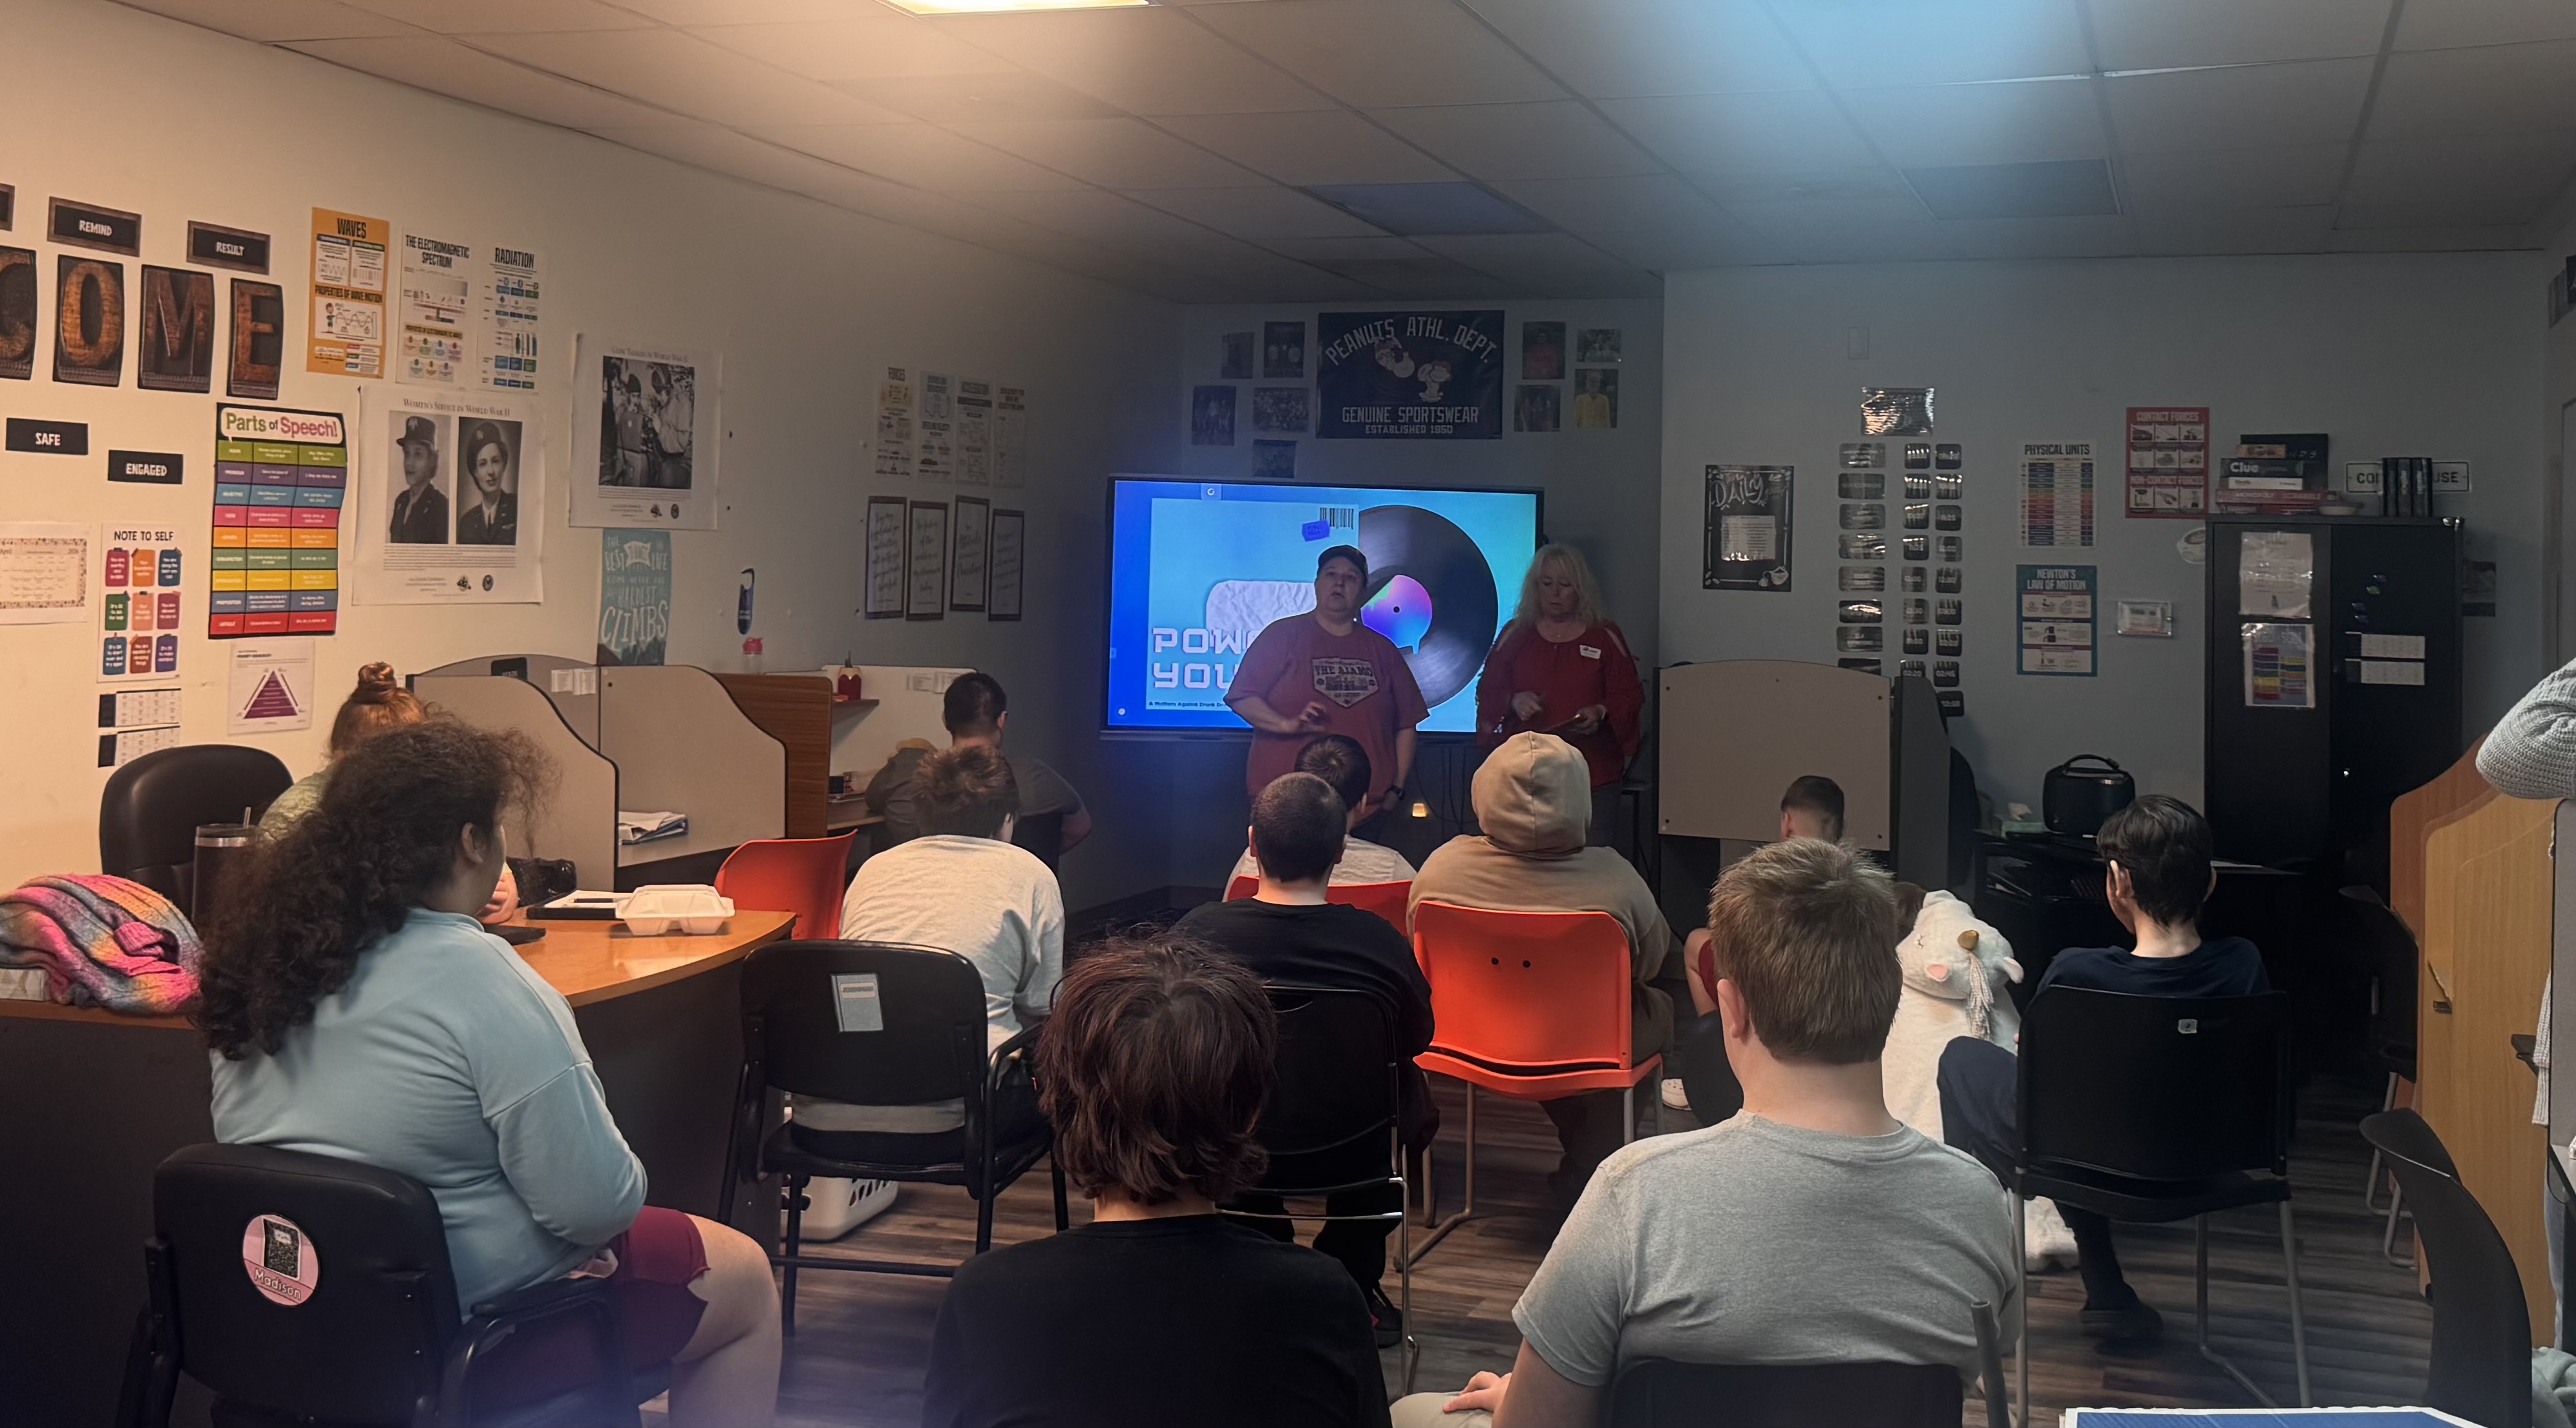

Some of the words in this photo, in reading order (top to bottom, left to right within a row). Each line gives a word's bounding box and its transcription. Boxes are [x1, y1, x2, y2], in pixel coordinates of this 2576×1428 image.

[79, 220, 112, 236] REMIND
[337, 218, 367, 239] WAVES
[216, 240, 244, 256] RESULT
[406, 235, 417, 249] THE
[495, 247, 535, 269] RADIATION
[1325, 319, 1395, 366] PEANUTS
[1407, 317, 1449, 341] ATHL.
[1453, 325, 1497, 363] DEPT.
[1342, 406, 1391, 423] GENUINE
[1397, 406, 1479, 423] SPORTSWEAR
[226, 412, 267, 432] Parts
[269, 419, 279, 431] of
[280, 416, 338, 438] Speech!
[1365, 424, 1426, 434] ESTABLISHED
[1431, 424, 1453, 434] 1950
[35, 432, 61, 446] SAFE
[2025, 444, 2064, 455] PHYSICAL
[2065, 444, 2090, 455] UNITS
[125, 463, 167, 476] ENGAGED
[2230, 461, 2260, 473] Clue
[114, 530, 138, 541] NOTE
[140, 530, 153, 541] TO
[154, 531, 174, 541] SELF
[2036, 568, 2076, 581] NEWTON'S
[601, 599, 668, 652] CLIMBS
[1314, 665, 1336, 675] THE
[1338, 665, 1374, 677] ALAMO
[255, 1268, 302, 1301] Madison
